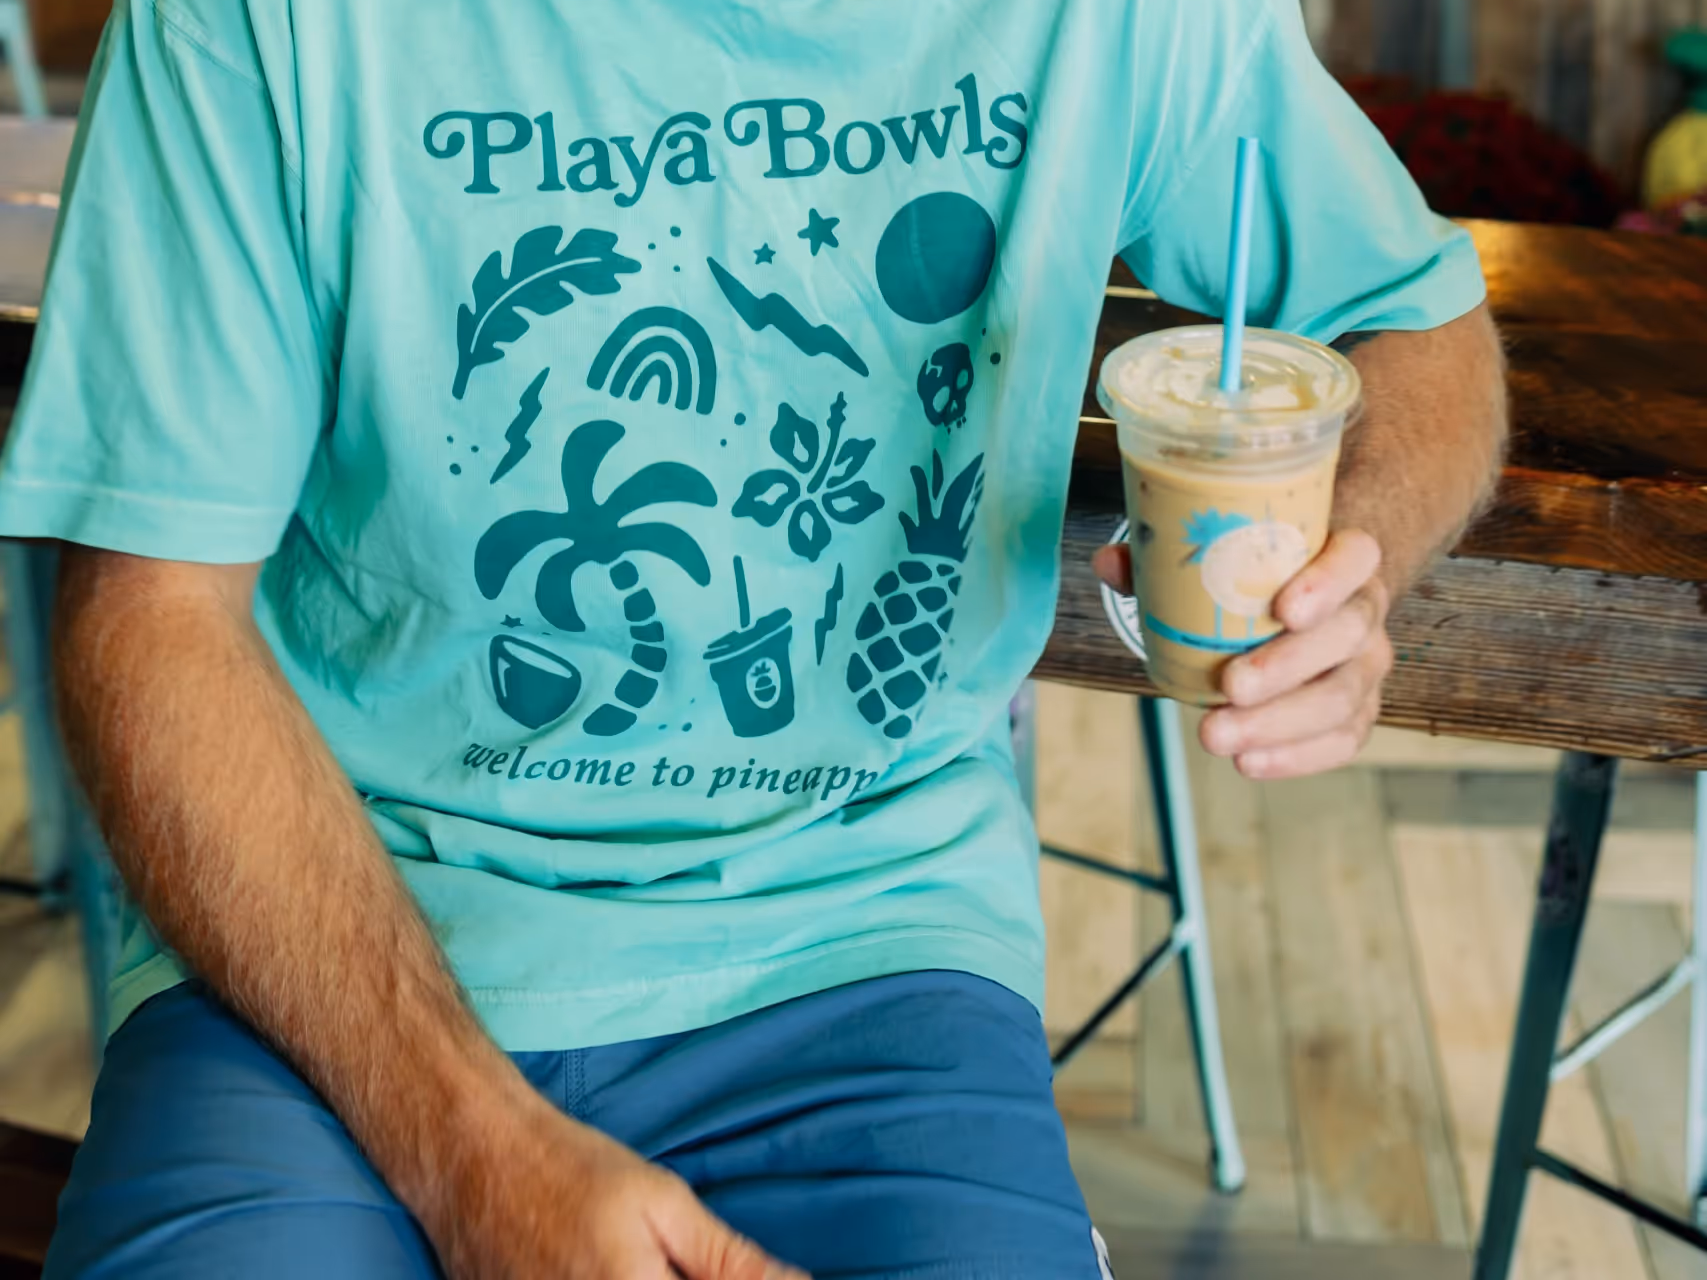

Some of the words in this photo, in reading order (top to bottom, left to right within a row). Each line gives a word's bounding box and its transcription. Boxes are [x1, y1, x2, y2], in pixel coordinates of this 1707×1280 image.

[424, 111, 716, 207] Playa
[724, 72, 1029, 179] Bowls
[463, 742, 636, 787] welcome
[651, 756, 695, 786] to
